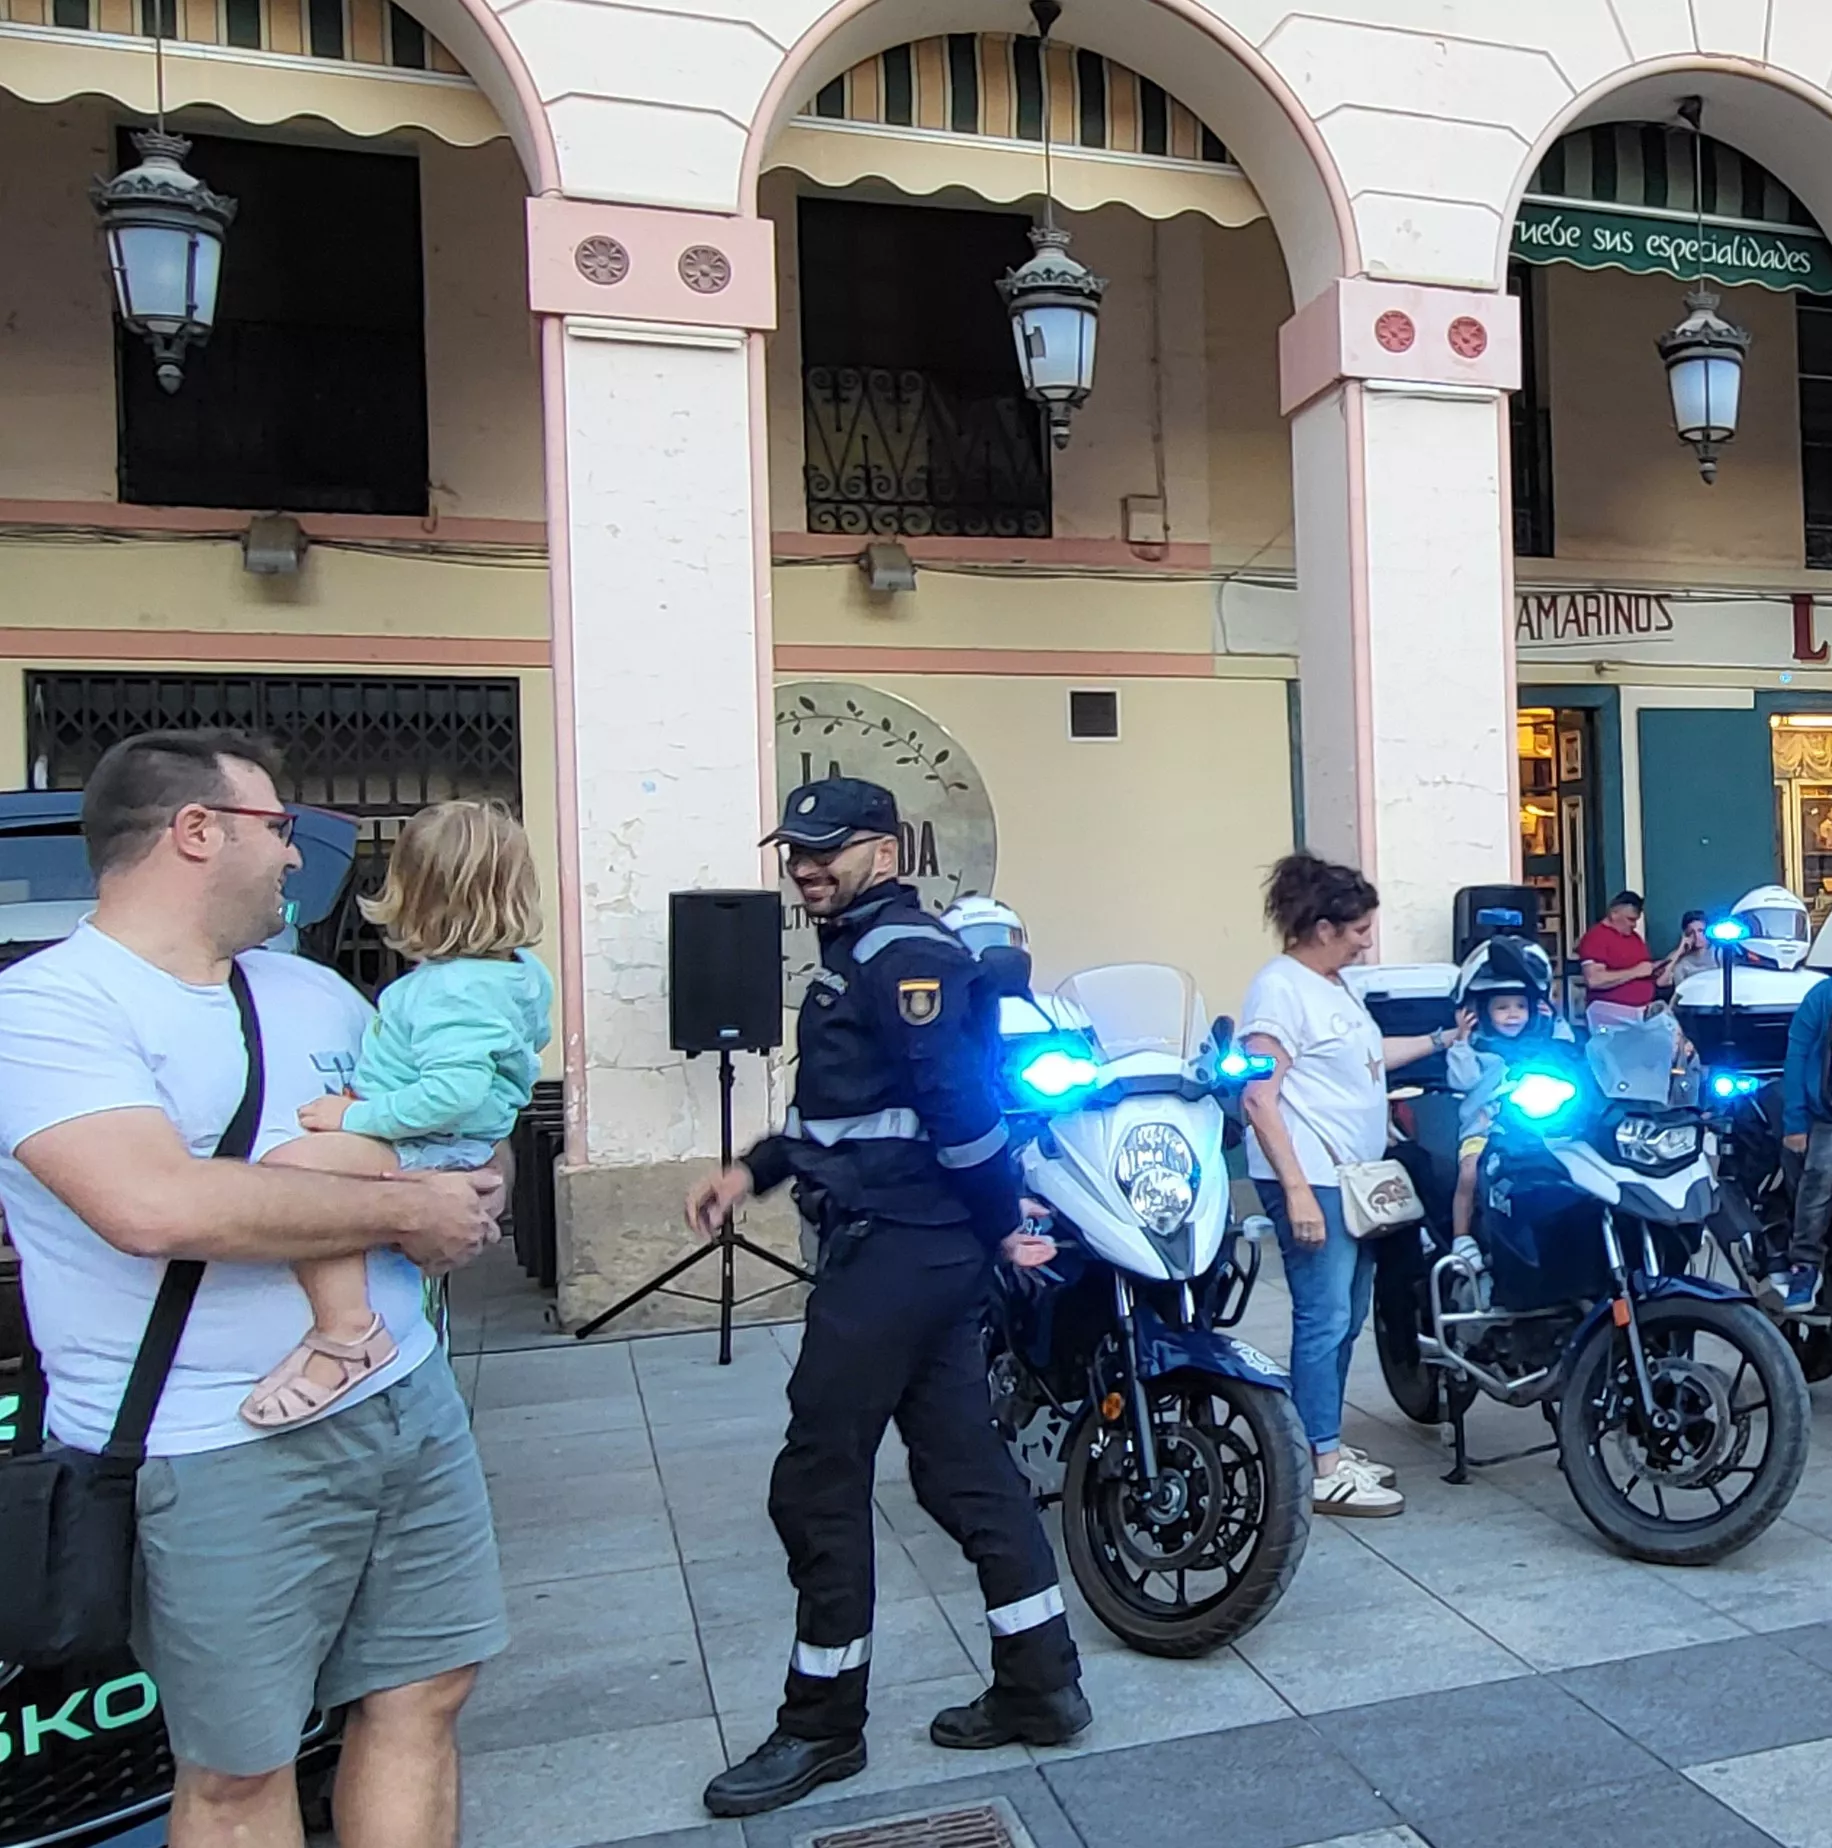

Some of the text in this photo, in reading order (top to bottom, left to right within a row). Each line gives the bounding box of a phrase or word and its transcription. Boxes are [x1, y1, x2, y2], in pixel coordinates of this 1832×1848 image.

[1592, 225, 1634, 254] sus
[1645, 230, 1812, 274] especialidades
[1515, 591, 1674, 641] AMARINOS
